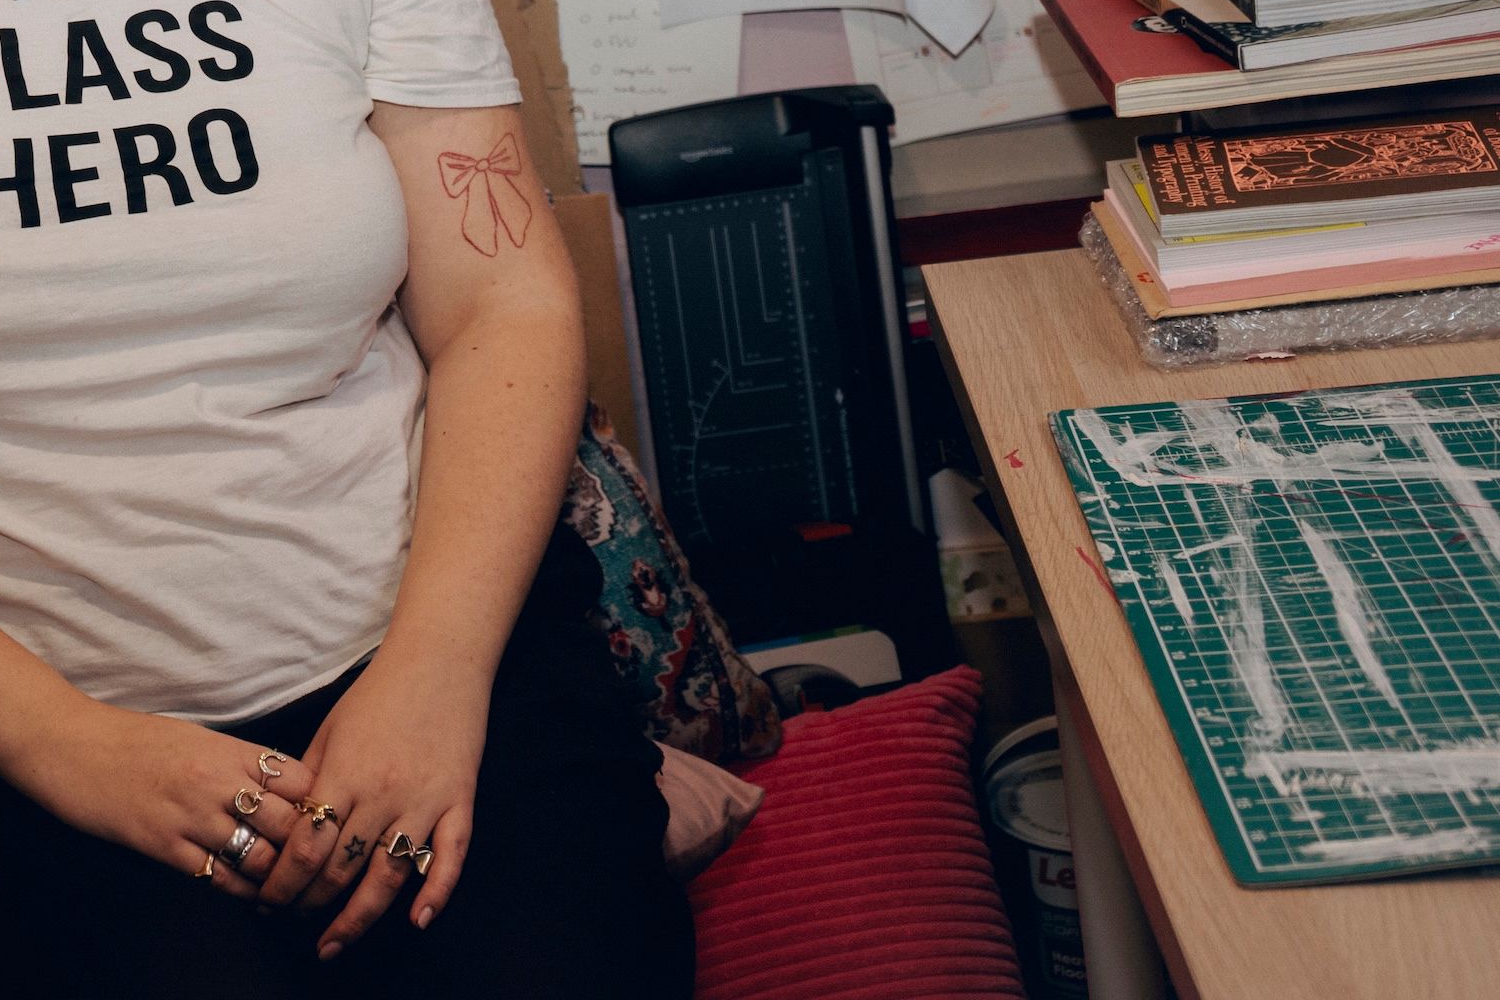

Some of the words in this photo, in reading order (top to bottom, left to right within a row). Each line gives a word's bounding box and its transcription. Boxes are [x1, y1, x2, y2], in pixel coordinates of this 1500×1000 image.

[1153, 144, 1175, 158] and
[1195, 141, 1217, 165] Messy
[1152, 157, 1188, 202] Typography
[1184, 173, 1208, 207] Printing
[1204, 165, 1224, 194] History
[1214, 195, 1236, 204] of
[1039, 856, 1077, 889] Le
